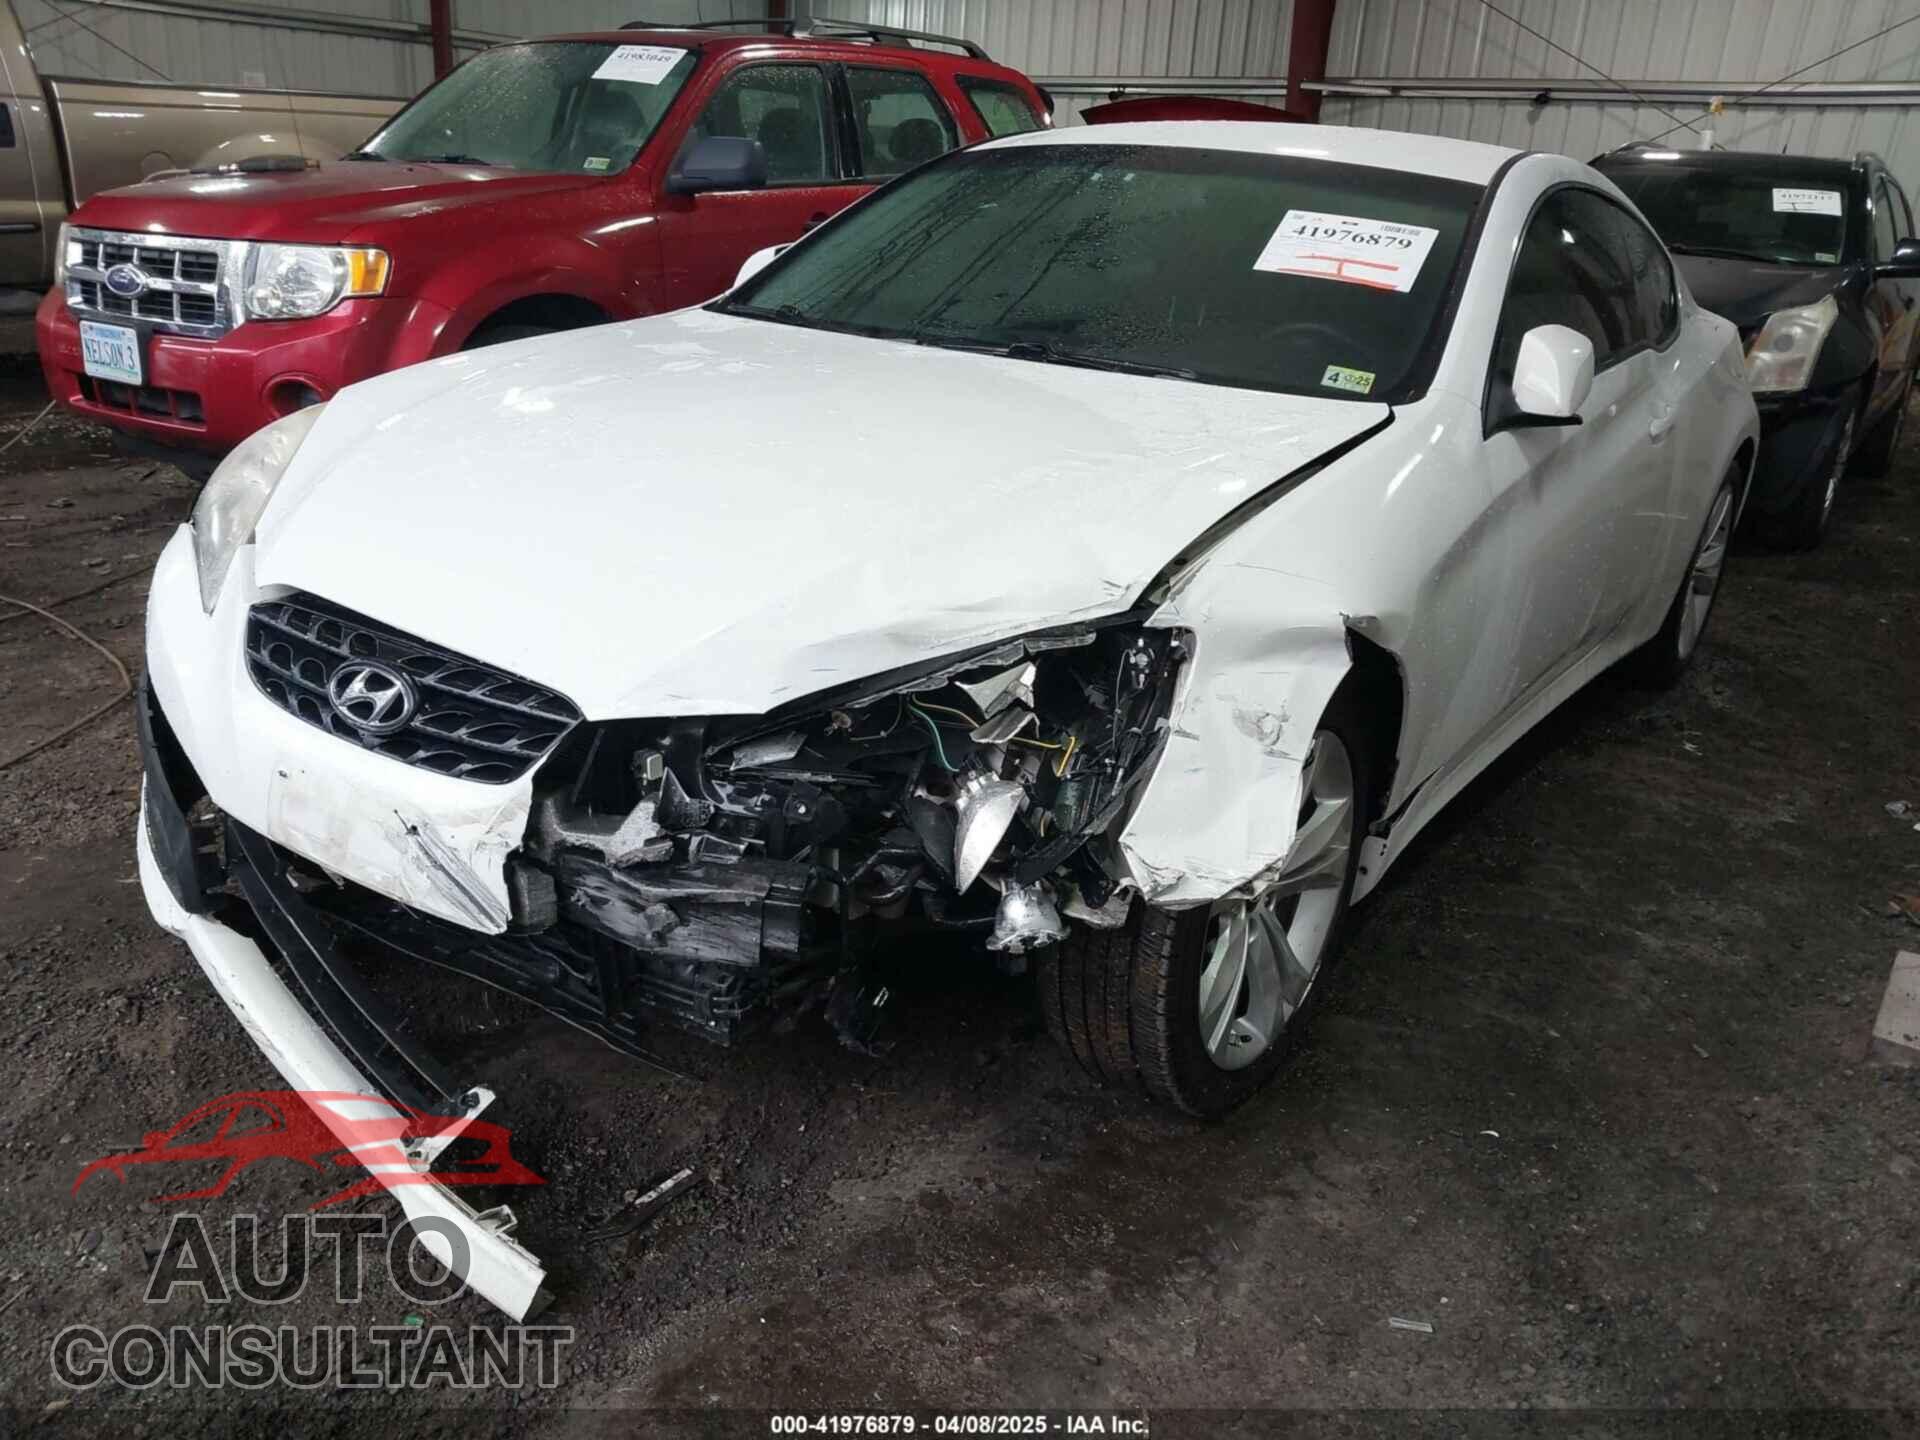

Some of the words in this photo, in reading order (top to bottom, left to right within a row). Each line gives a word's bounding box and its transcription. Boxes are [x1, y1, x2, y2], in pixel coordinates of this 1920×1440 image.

[1292, 225, 1413, 249] 41976879
[84, 336, 124, 368] NELSON
[126, 345, 135, 370] 3
[1327, 372, 1340, 384] 4
[1356, 375, 1371, 386] 25
